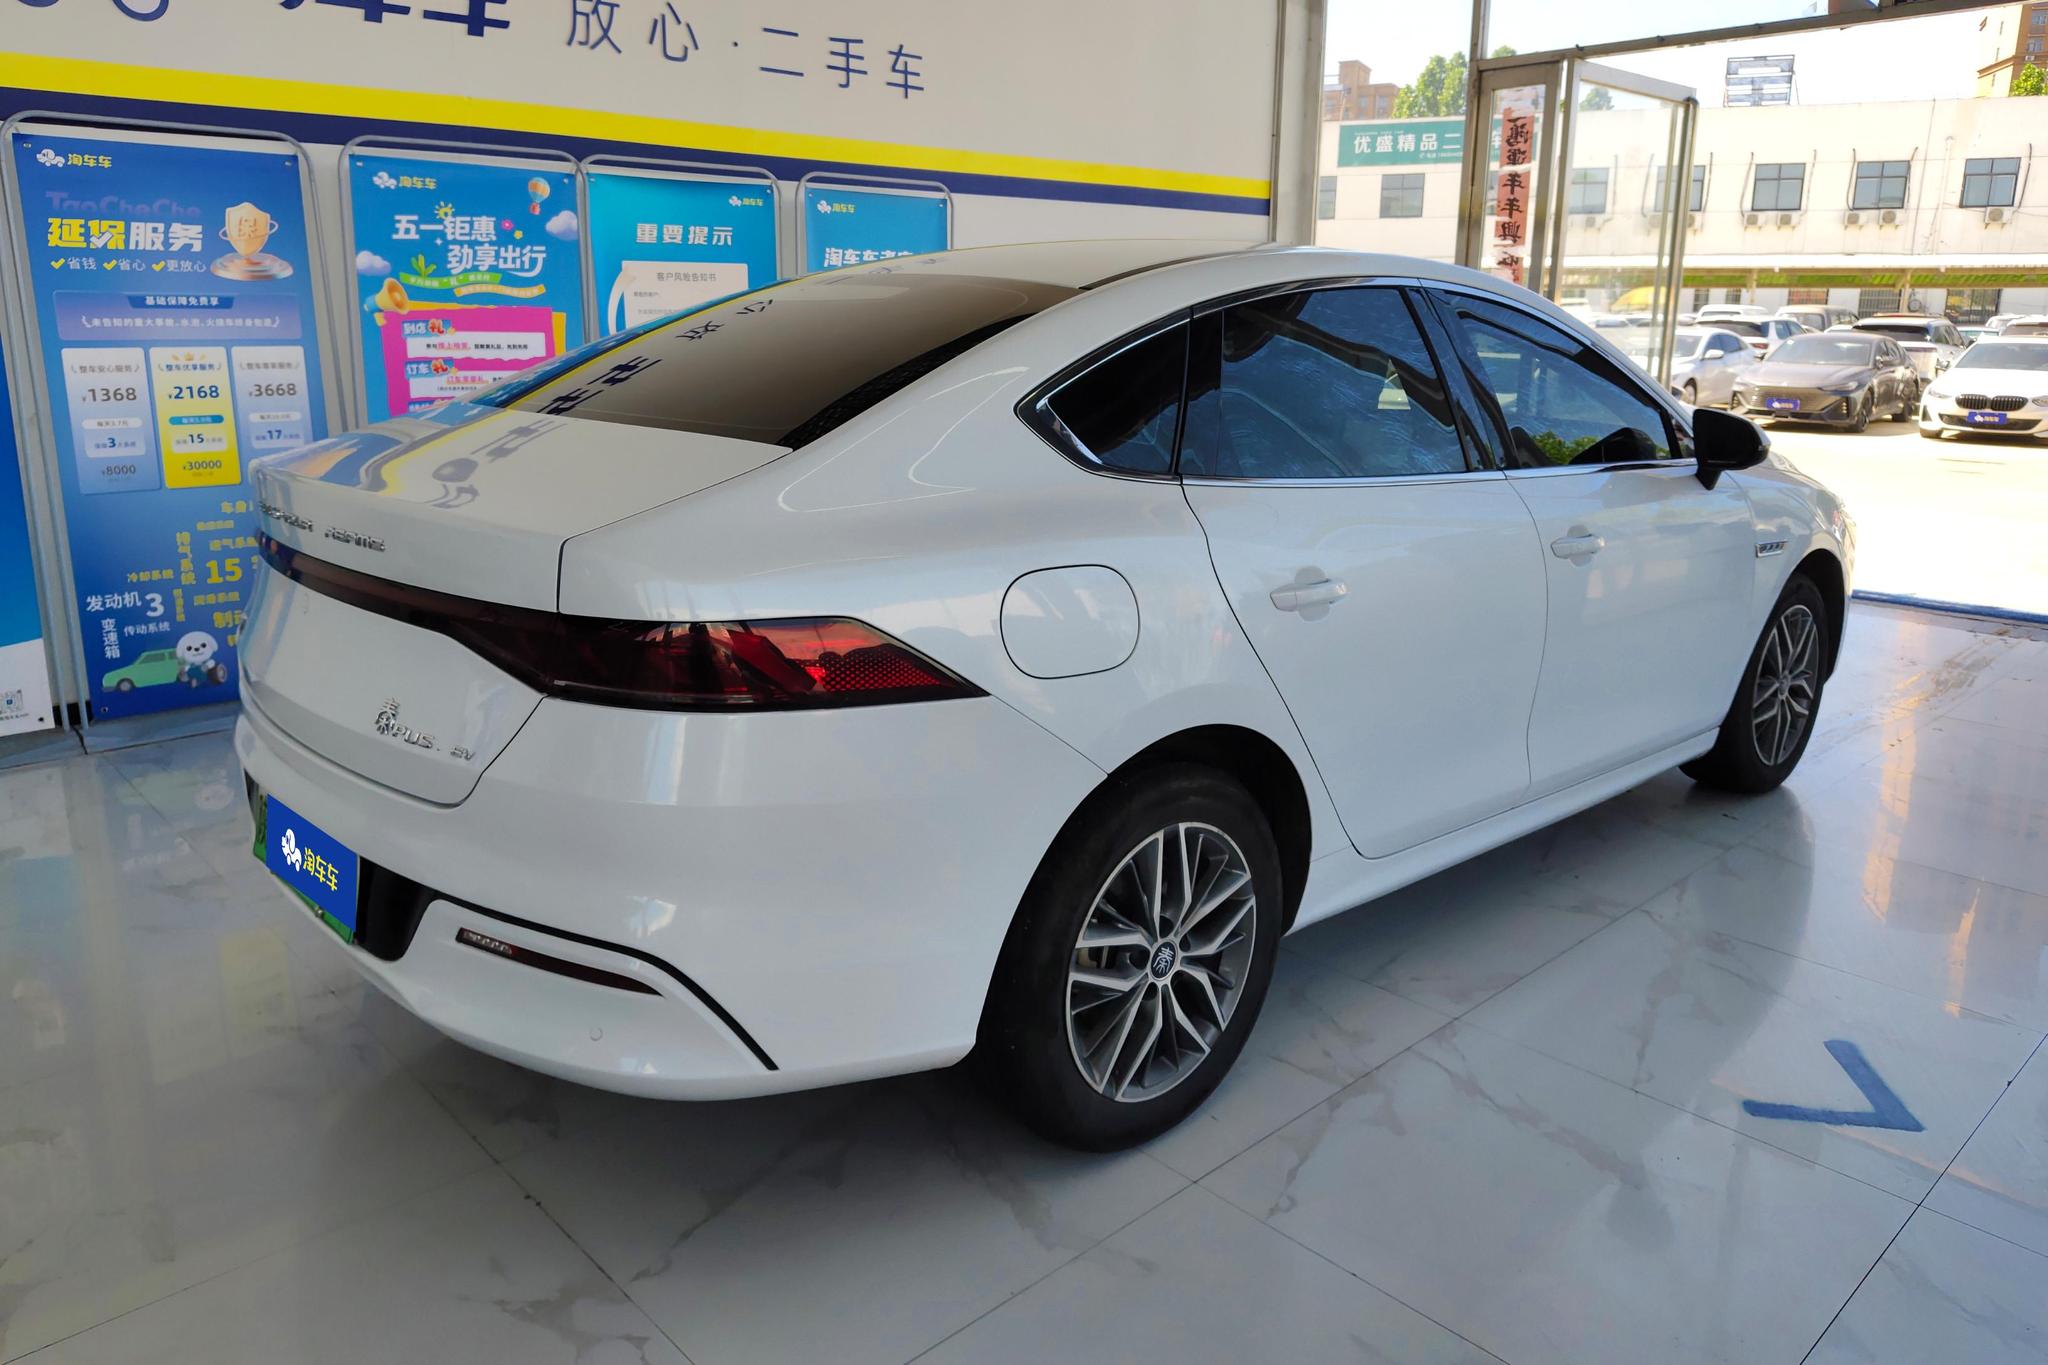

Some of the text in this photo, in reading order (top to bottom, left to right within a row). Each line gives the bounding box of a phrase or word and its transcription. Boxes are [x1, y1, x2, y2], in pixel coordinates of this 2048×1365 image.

[67, 153, 112, 168] 淘车车
[399, 176, 437, 189] 淘车车
[48, 217, 203, 252] 延保服务
[392, 214, 497, 242] 五一钜惠
[636, 223, 733, 247] 重要提示
[67, 257, 207, 273] 省钱 省心 更放心
[447, 244, 546, 276] 劲享出行
[656, 271, 717, 282] 客户风险告知书
[205, 558, 242, 584] 15
[86, 591, 142, 612] 发动机
[145, 593, 165, 617] 3
[101, 618, 120, 659] 变速箱
[124, 621, 171, 637] 传动系统
